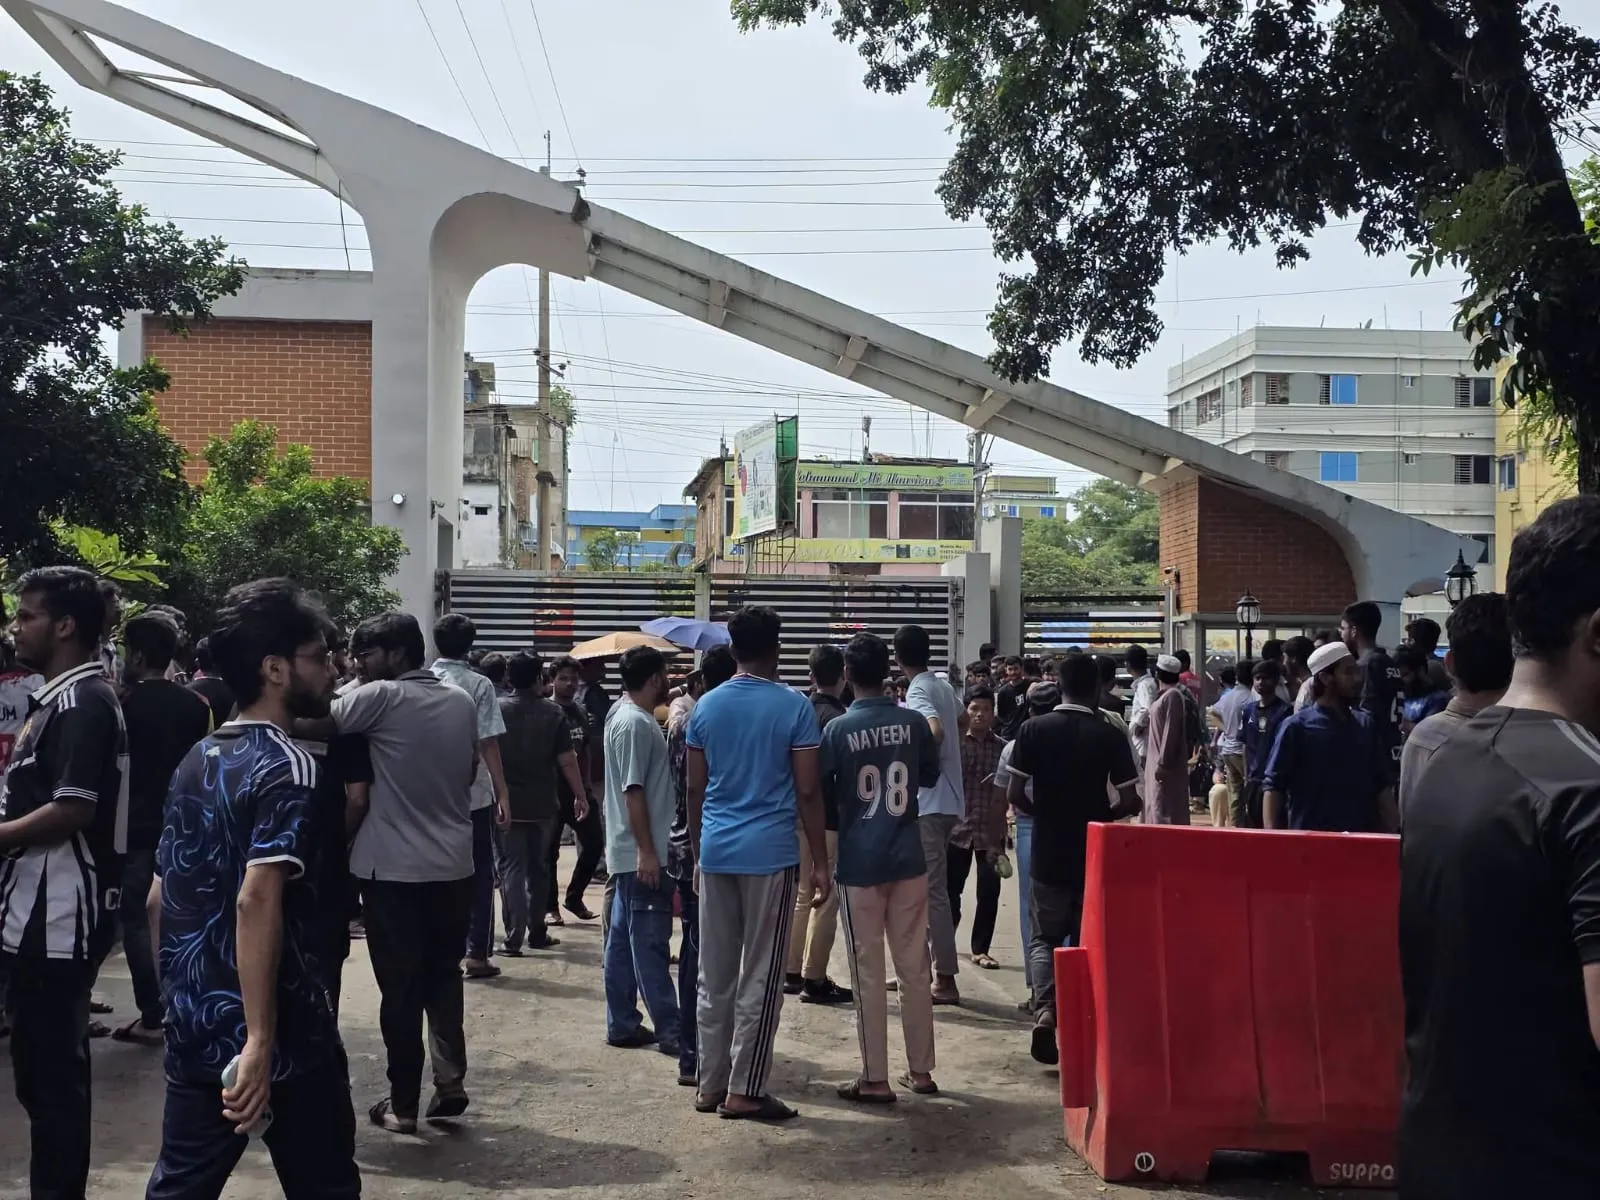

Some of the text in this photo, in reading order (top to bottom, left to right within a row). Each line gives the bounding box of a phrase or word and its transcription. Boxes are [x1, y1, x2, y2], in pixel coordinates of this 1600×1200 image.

[847, 725, 911, 752] NAYEEM
[857, 761, 909, 819] 98
[1329, 1162, 1394, 1181] SUPPO
